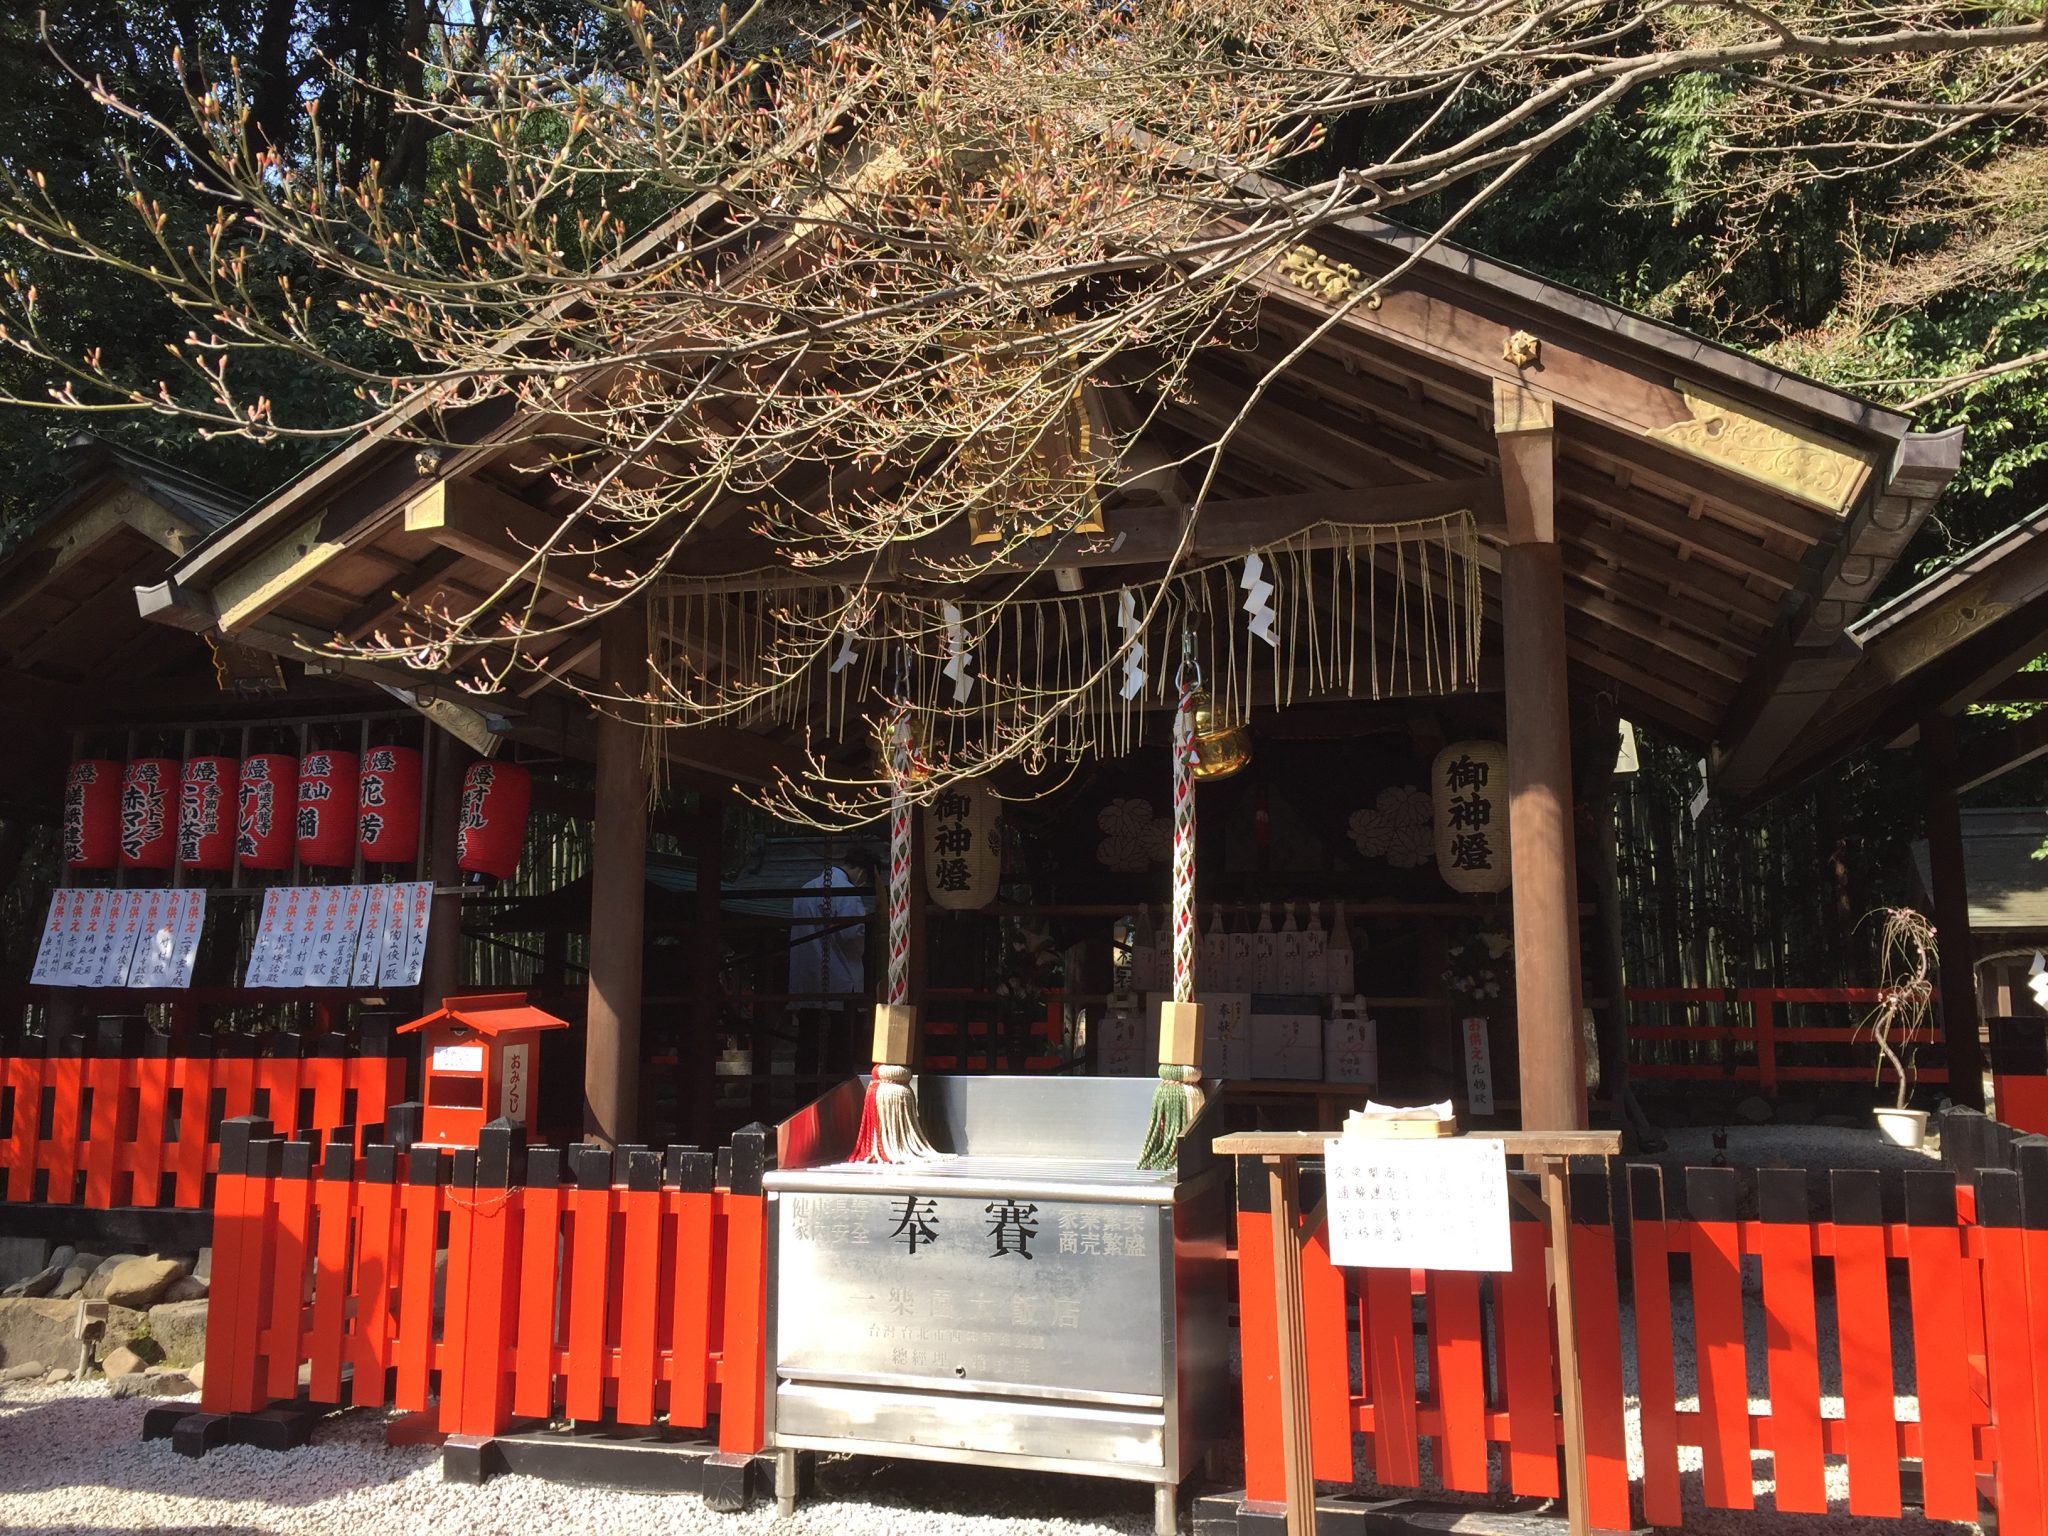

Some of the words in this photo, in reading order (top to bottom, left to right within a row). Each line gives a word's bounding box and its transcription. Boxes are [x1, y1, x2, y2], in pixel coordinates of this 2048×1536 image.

[121, 785, 146, 859] 赤マンマ
[145, 783, 168, 842] レストラン
[202, 784, 222, 834] 季節料理
[1446, 754, 1493, 871] 御神燈
[933, 787, 972, 892] 御神燈
[509, 1054, 521, 1114] おみくじ
[1058, 1231, 1146, 1257] 商売繁盛
